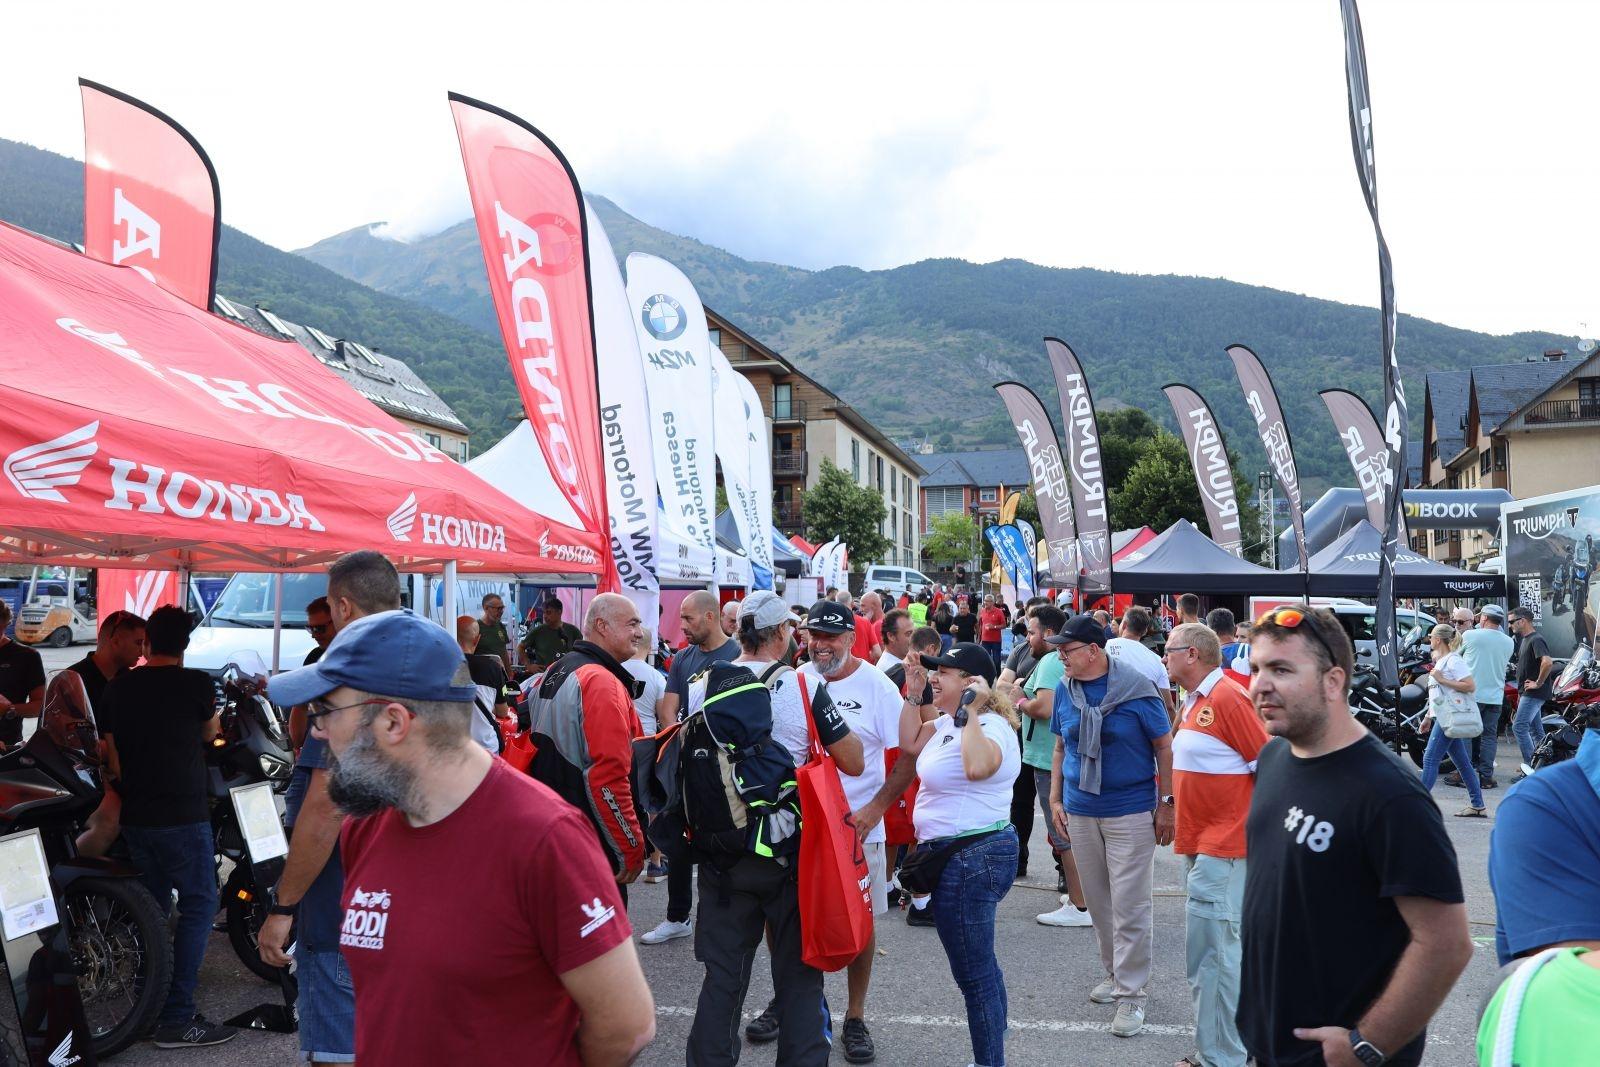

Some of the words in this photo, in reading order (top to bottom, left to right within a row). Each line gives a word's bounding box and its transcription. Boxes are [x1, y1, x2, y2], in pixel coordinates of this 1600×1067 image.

[168, 366, 445, 463] HODA
[104, 457, 326, 532] HONDA
[420, 512, 508, 553] HONDA
[1512, 512, 1566, 538] TRIUMPH
[1443, 581, 1485, 592] TRIUMPH
[718, 674, 757, 691] RST
[1284, 805, 1335, 853] #18
[341, 908, 389, 938] RODI
